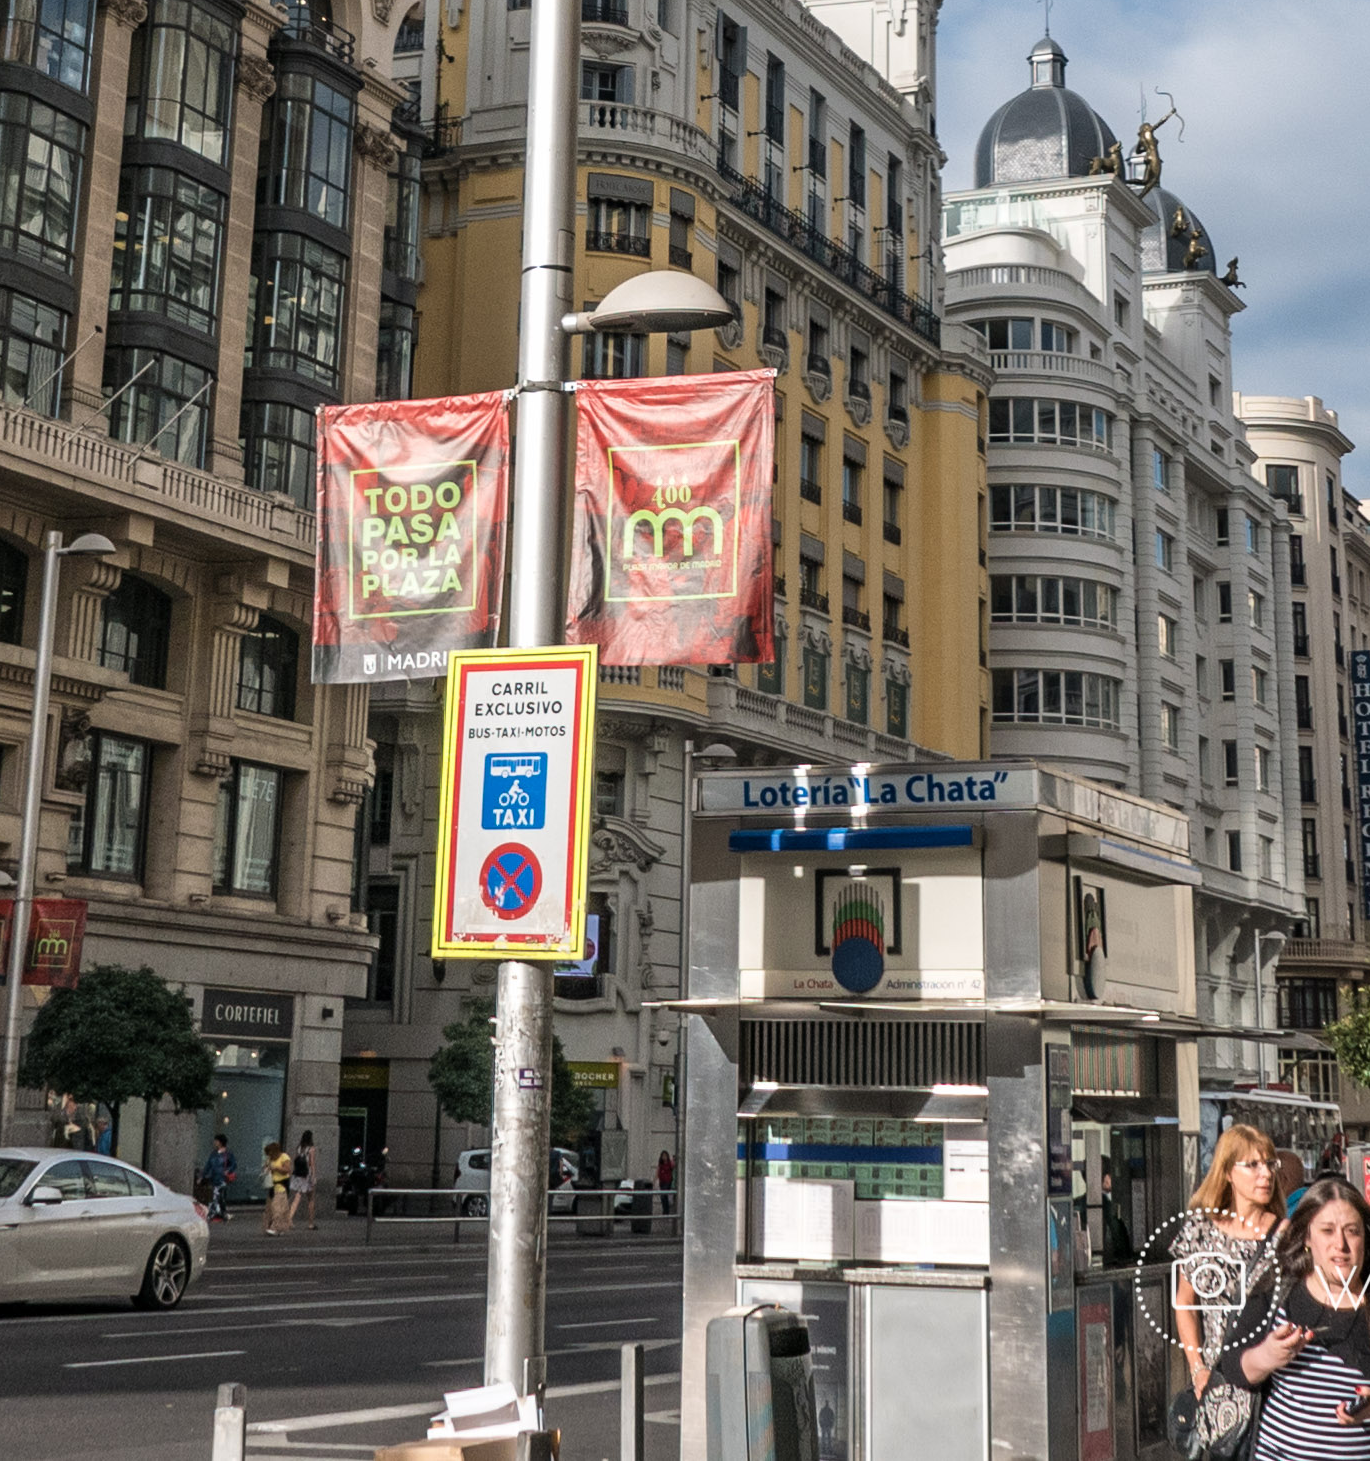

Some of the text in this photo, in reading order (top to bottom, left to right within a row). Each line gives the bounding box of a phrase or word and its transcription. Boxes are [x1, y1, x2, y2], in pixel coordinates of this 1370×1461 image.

[363, 481, 461, 515] TODO
[651, 485, 691, 509] 400
[362, 512, 461, 547] PASA
[362, 544, 462, 571] POR LA
[362, 568, 463, 599] PLAZA
[387, 651, 448, 670] MADRI
[492, 682, 548, 696] CARRIL
[475, 701, 563, 716] EXCLUSIVO
[743, 778, 848, 808] Lotería
[492, 808, 534, 826] TAXI
[793, 979, 805, 989] La
[806, 978, 834, 989] Chata
[887, 978, 954, 989] Administración
[970, 979, 981, 989] 42
[215, 1004, 280, 1025] CORTEFIEL
